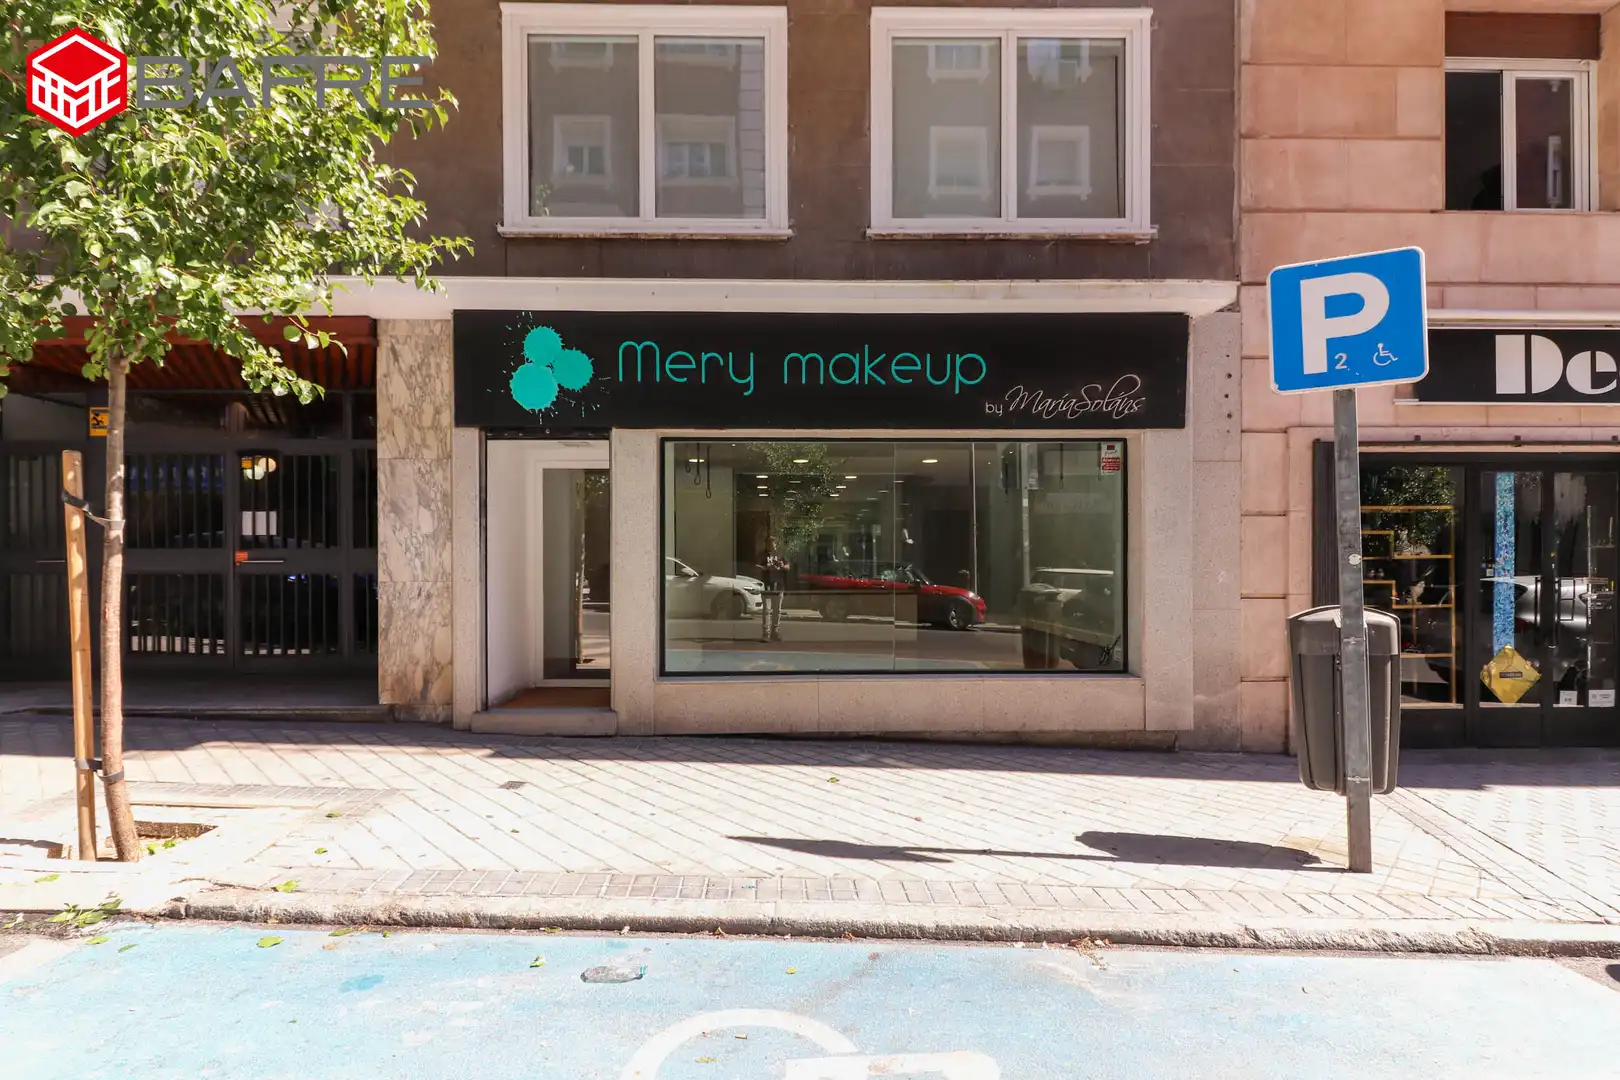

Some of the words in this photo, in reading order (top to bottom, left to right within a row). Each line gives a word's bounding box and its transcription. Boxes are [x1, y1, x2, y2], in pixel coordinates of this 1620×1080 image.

[1300, 272, 1390, 375] P
[619, 341, 754, 395] Mery
[784, 344, 987, 394] makeup
[1334, 353, 1348, 370] 2
[1495, 334, 1620, 395] De
[986, 402, 1003, 416] by
